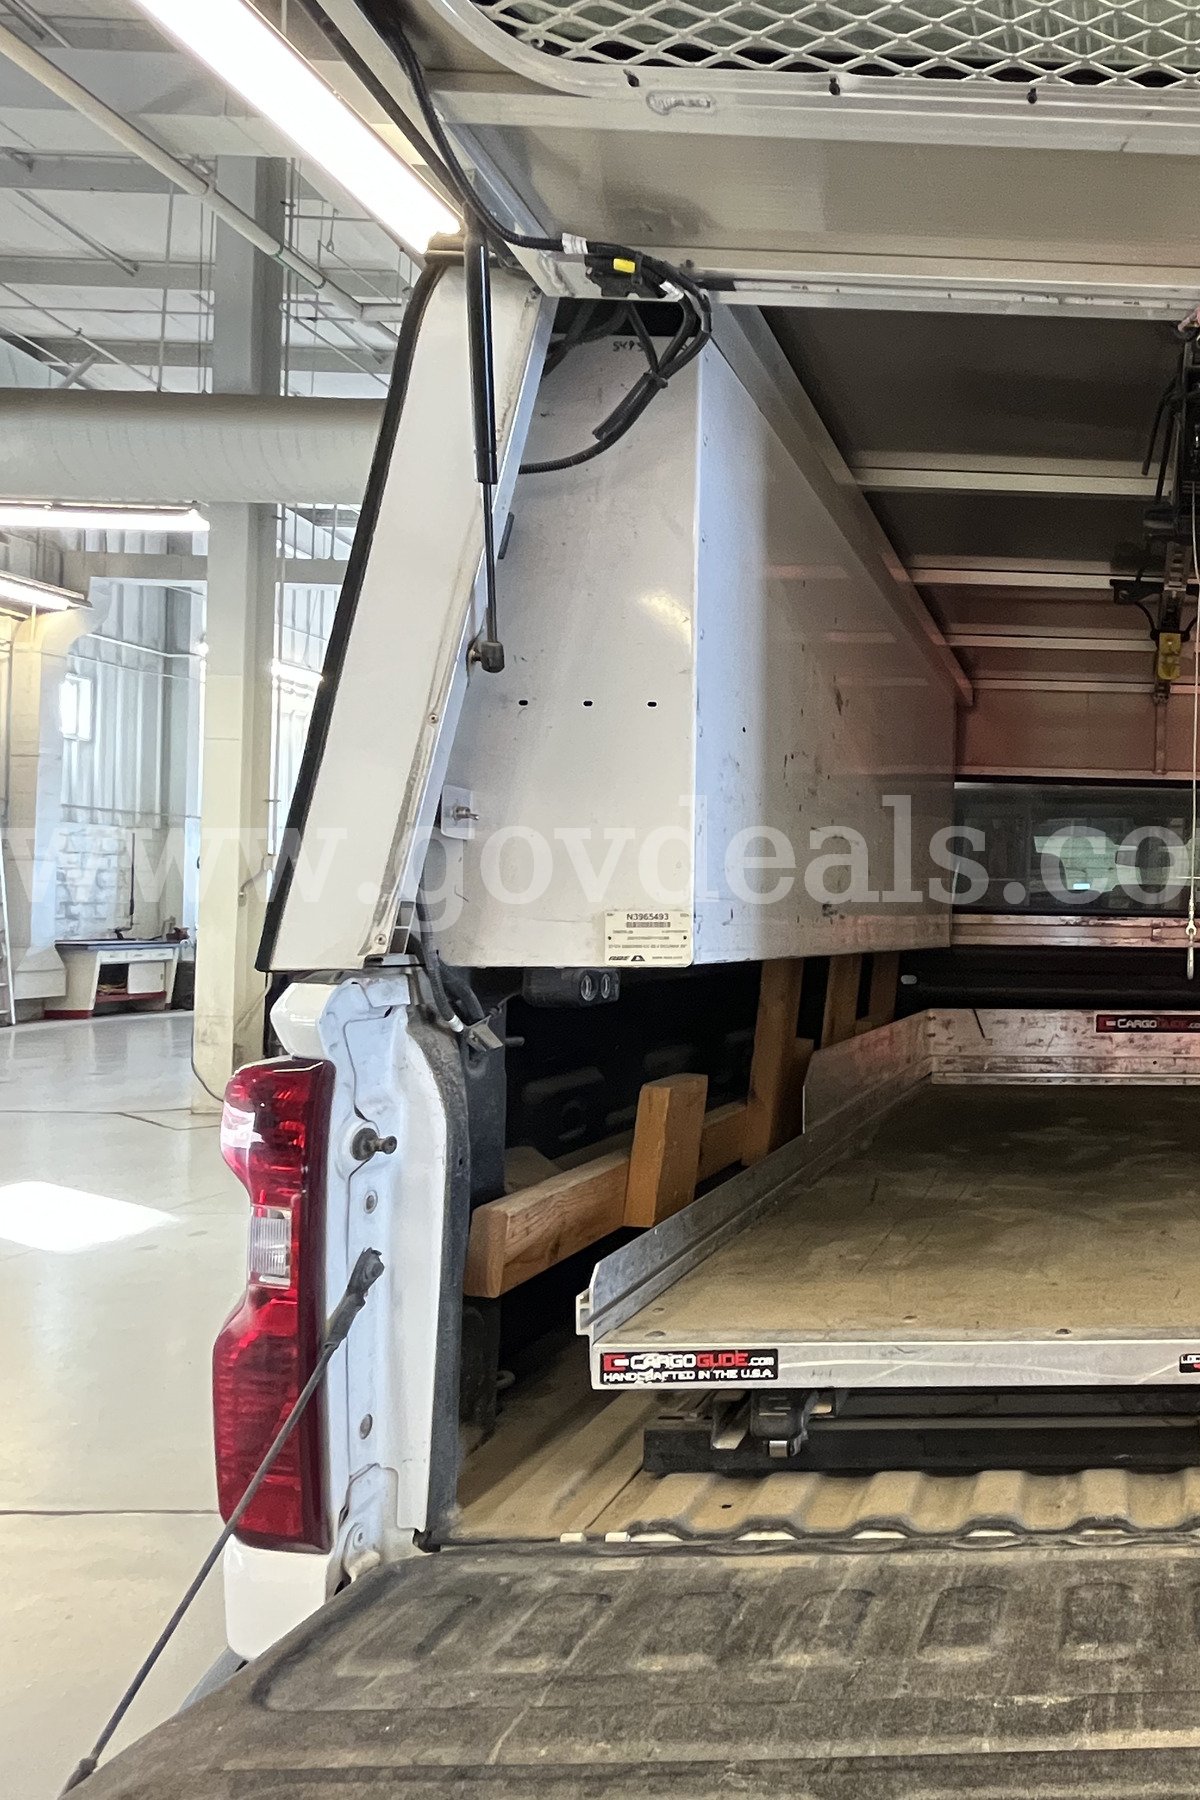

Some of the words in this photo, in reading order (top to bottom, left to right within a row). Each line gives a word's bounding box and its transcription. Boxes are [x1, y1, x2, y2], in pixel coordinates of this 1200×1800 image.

[626, 912, 669, 920] N3965493
[698, 1370, 710, 1380] IN
[712, 1369, 738, 1379] THE
